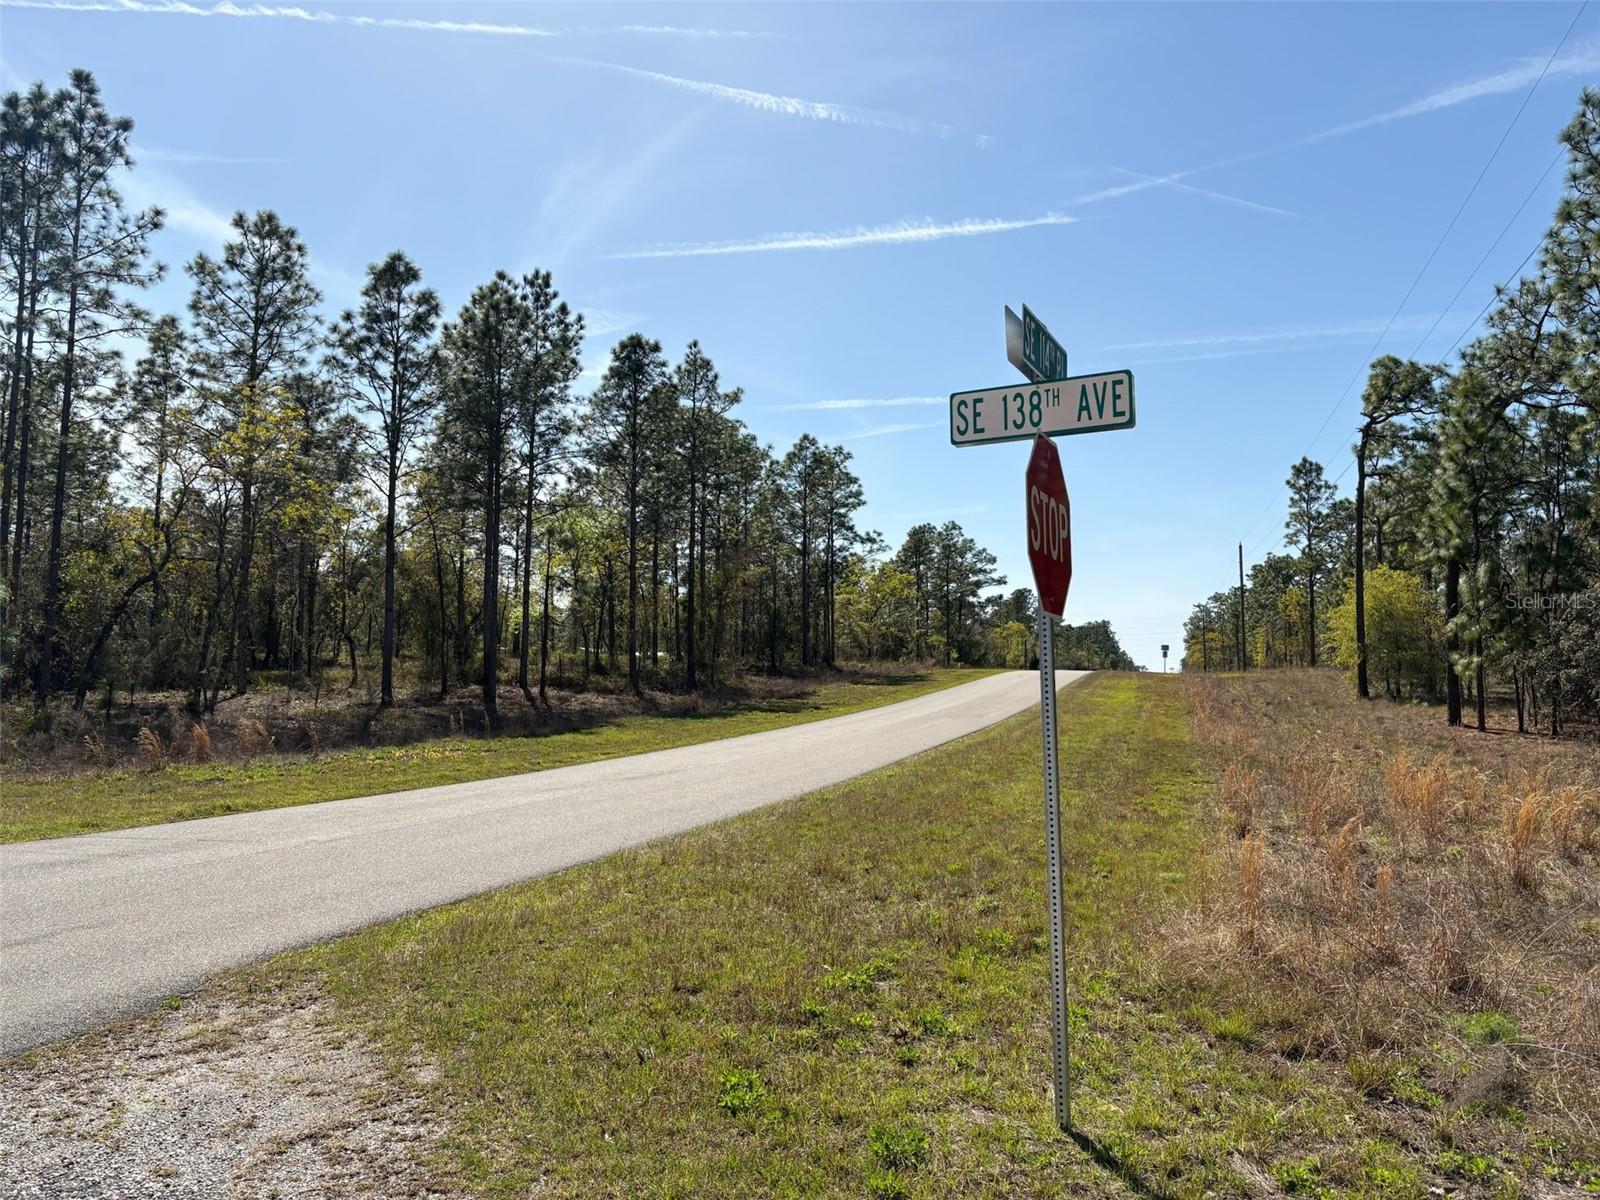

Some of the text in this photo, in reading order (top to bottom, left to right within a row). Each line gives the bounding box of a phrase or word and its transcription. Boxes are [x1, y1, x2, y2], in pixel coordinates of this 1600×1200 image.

[1025, 316, 1036, 362] SE
[956, 378, 1126, 436] SE 138TH AVE
[1030, 485, 1068, 563] STOP
